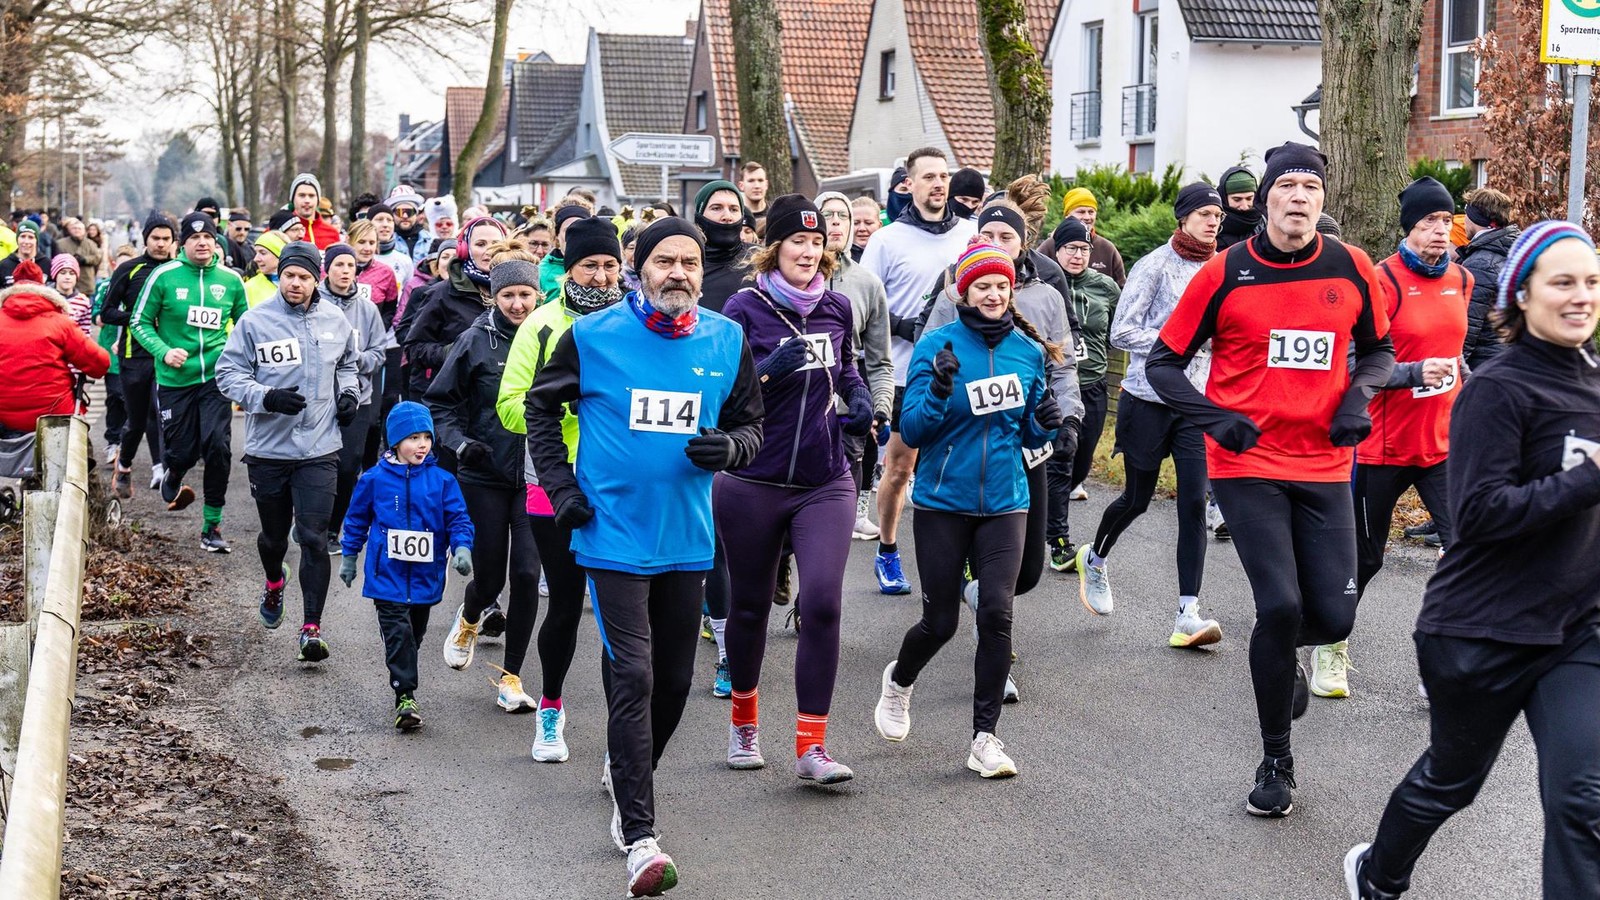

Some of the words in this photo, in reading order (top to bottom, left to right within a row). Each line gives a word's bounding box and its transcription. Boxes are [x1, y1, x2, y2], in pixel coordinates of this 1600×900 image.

[1551, 43, 1561, 52] 16
[190, 309, 219, 326] 102
[258, 343, 298, 364] 161
[1275, 336, 1329, 364] 199
[972, 379, 1020, 410] 194
[635, 396, 695, 428] 114
[391, 534, 430, 558] 160
